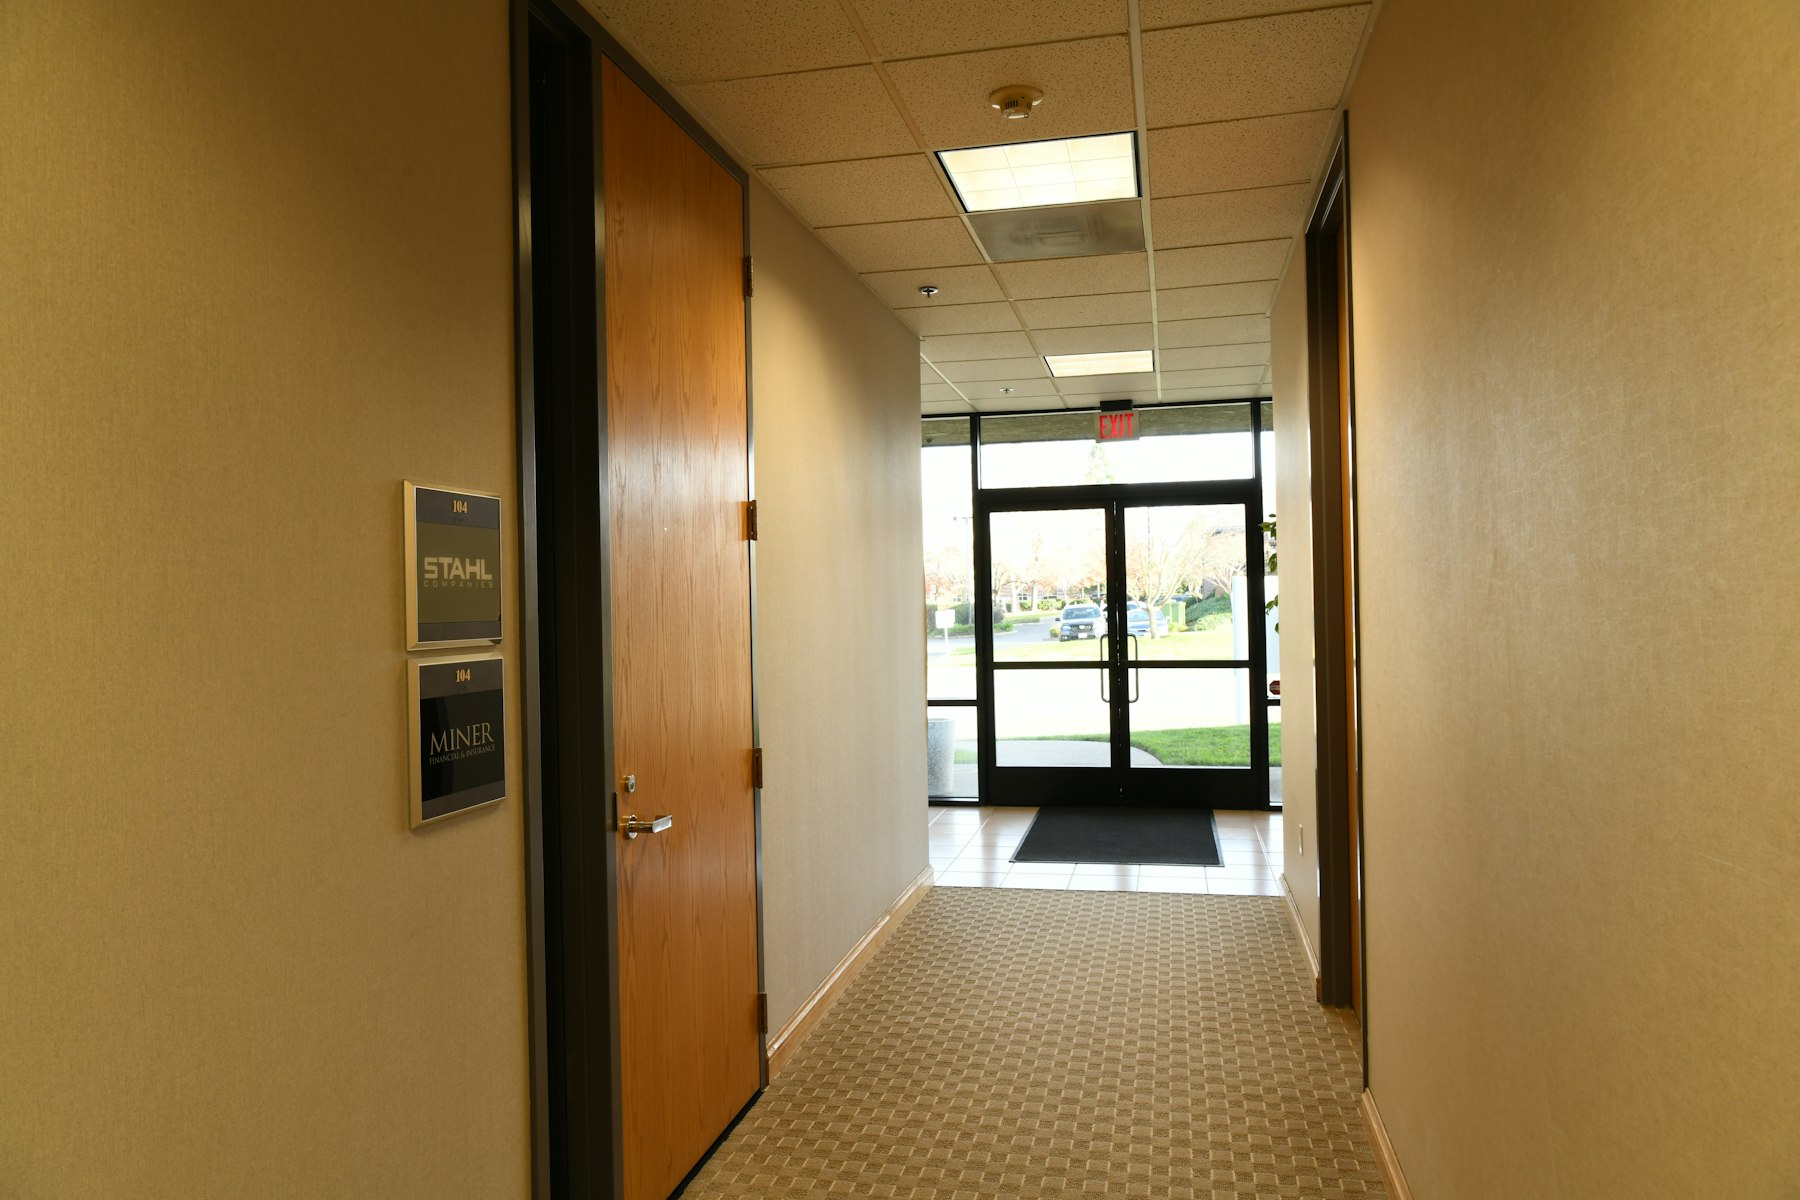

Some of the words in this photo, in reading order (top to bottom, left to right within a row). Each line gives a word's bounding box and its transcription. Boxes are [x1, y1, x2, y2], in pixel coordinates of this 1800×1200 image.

[1099, 413, 1134, 439] EXIT
[453, 500, 467, 513] 104
[424, 557, 492, 580] STAHL
[456, 669, 470, 682] 104
[430, 723, 494, 755] MINER
[429, 753, 460, 765] FINANCIAL
[466, 744, 495, 756] INSURANCE
